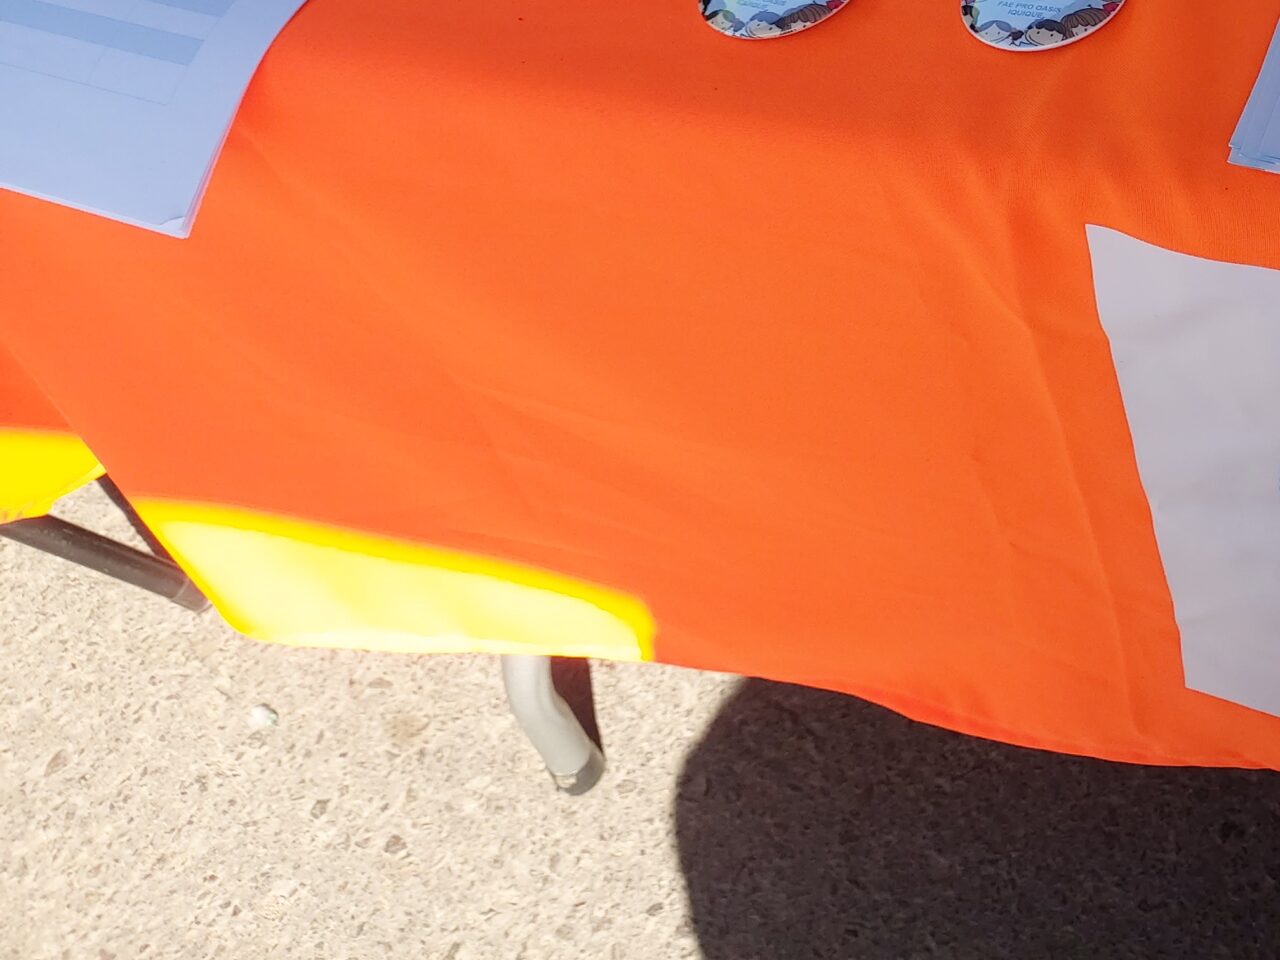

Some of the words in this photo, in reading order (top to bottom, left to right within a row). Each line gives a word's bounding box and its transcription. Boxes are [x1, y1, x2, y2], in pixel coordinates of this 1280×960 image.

[997, 0, 1016, 9] FAE
[1016, 2, 1035, 11] PRO
[1036, 4, 1063, 13] OASIS
[1007, 10, 1044, 20] IQUIQUE
